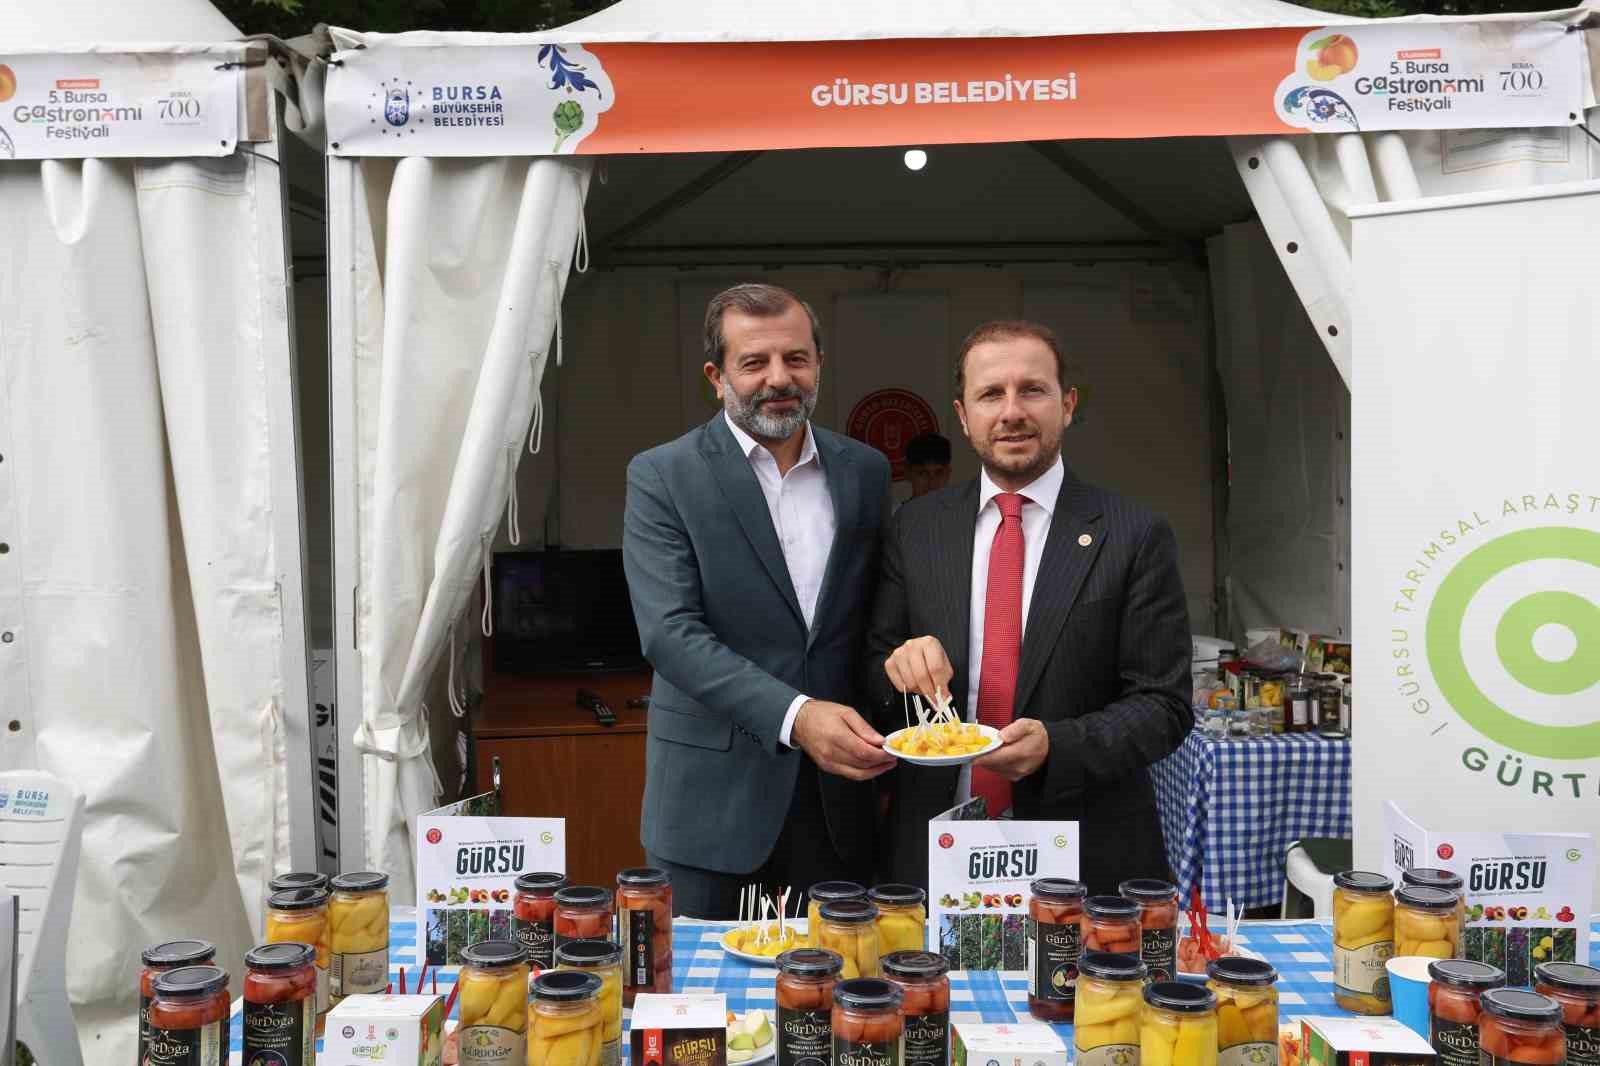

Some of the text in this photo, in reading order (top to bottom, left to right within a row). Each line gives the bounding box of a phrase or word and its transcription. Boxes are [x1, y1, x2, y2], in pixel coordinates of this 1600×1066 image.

[1390, 61, 1449, 75] 5. Bursa
[1500, 70, 1543, 91] 700
[48, 90, 108, 104] 5. Bursa
[432, 86, 502, 100] BURSA
[811, 72, 1077, 106] GÜRSU BELEDİYESİ
[157, 99, 200, 119] 700
[434, 114, 504, 127] BELEDİYESİ
[1393, 510, 1490, 614] TARIMSAL
[1391, 628, 1431, 715] GÜRSU
[1461, 747, 1600, 798] GÜRT
[455, 845, 525, 875] GÜRSU
[968, 849, 1038, 879] GÜRSU
[1469, 862, 1547, 892] GÜRSU
